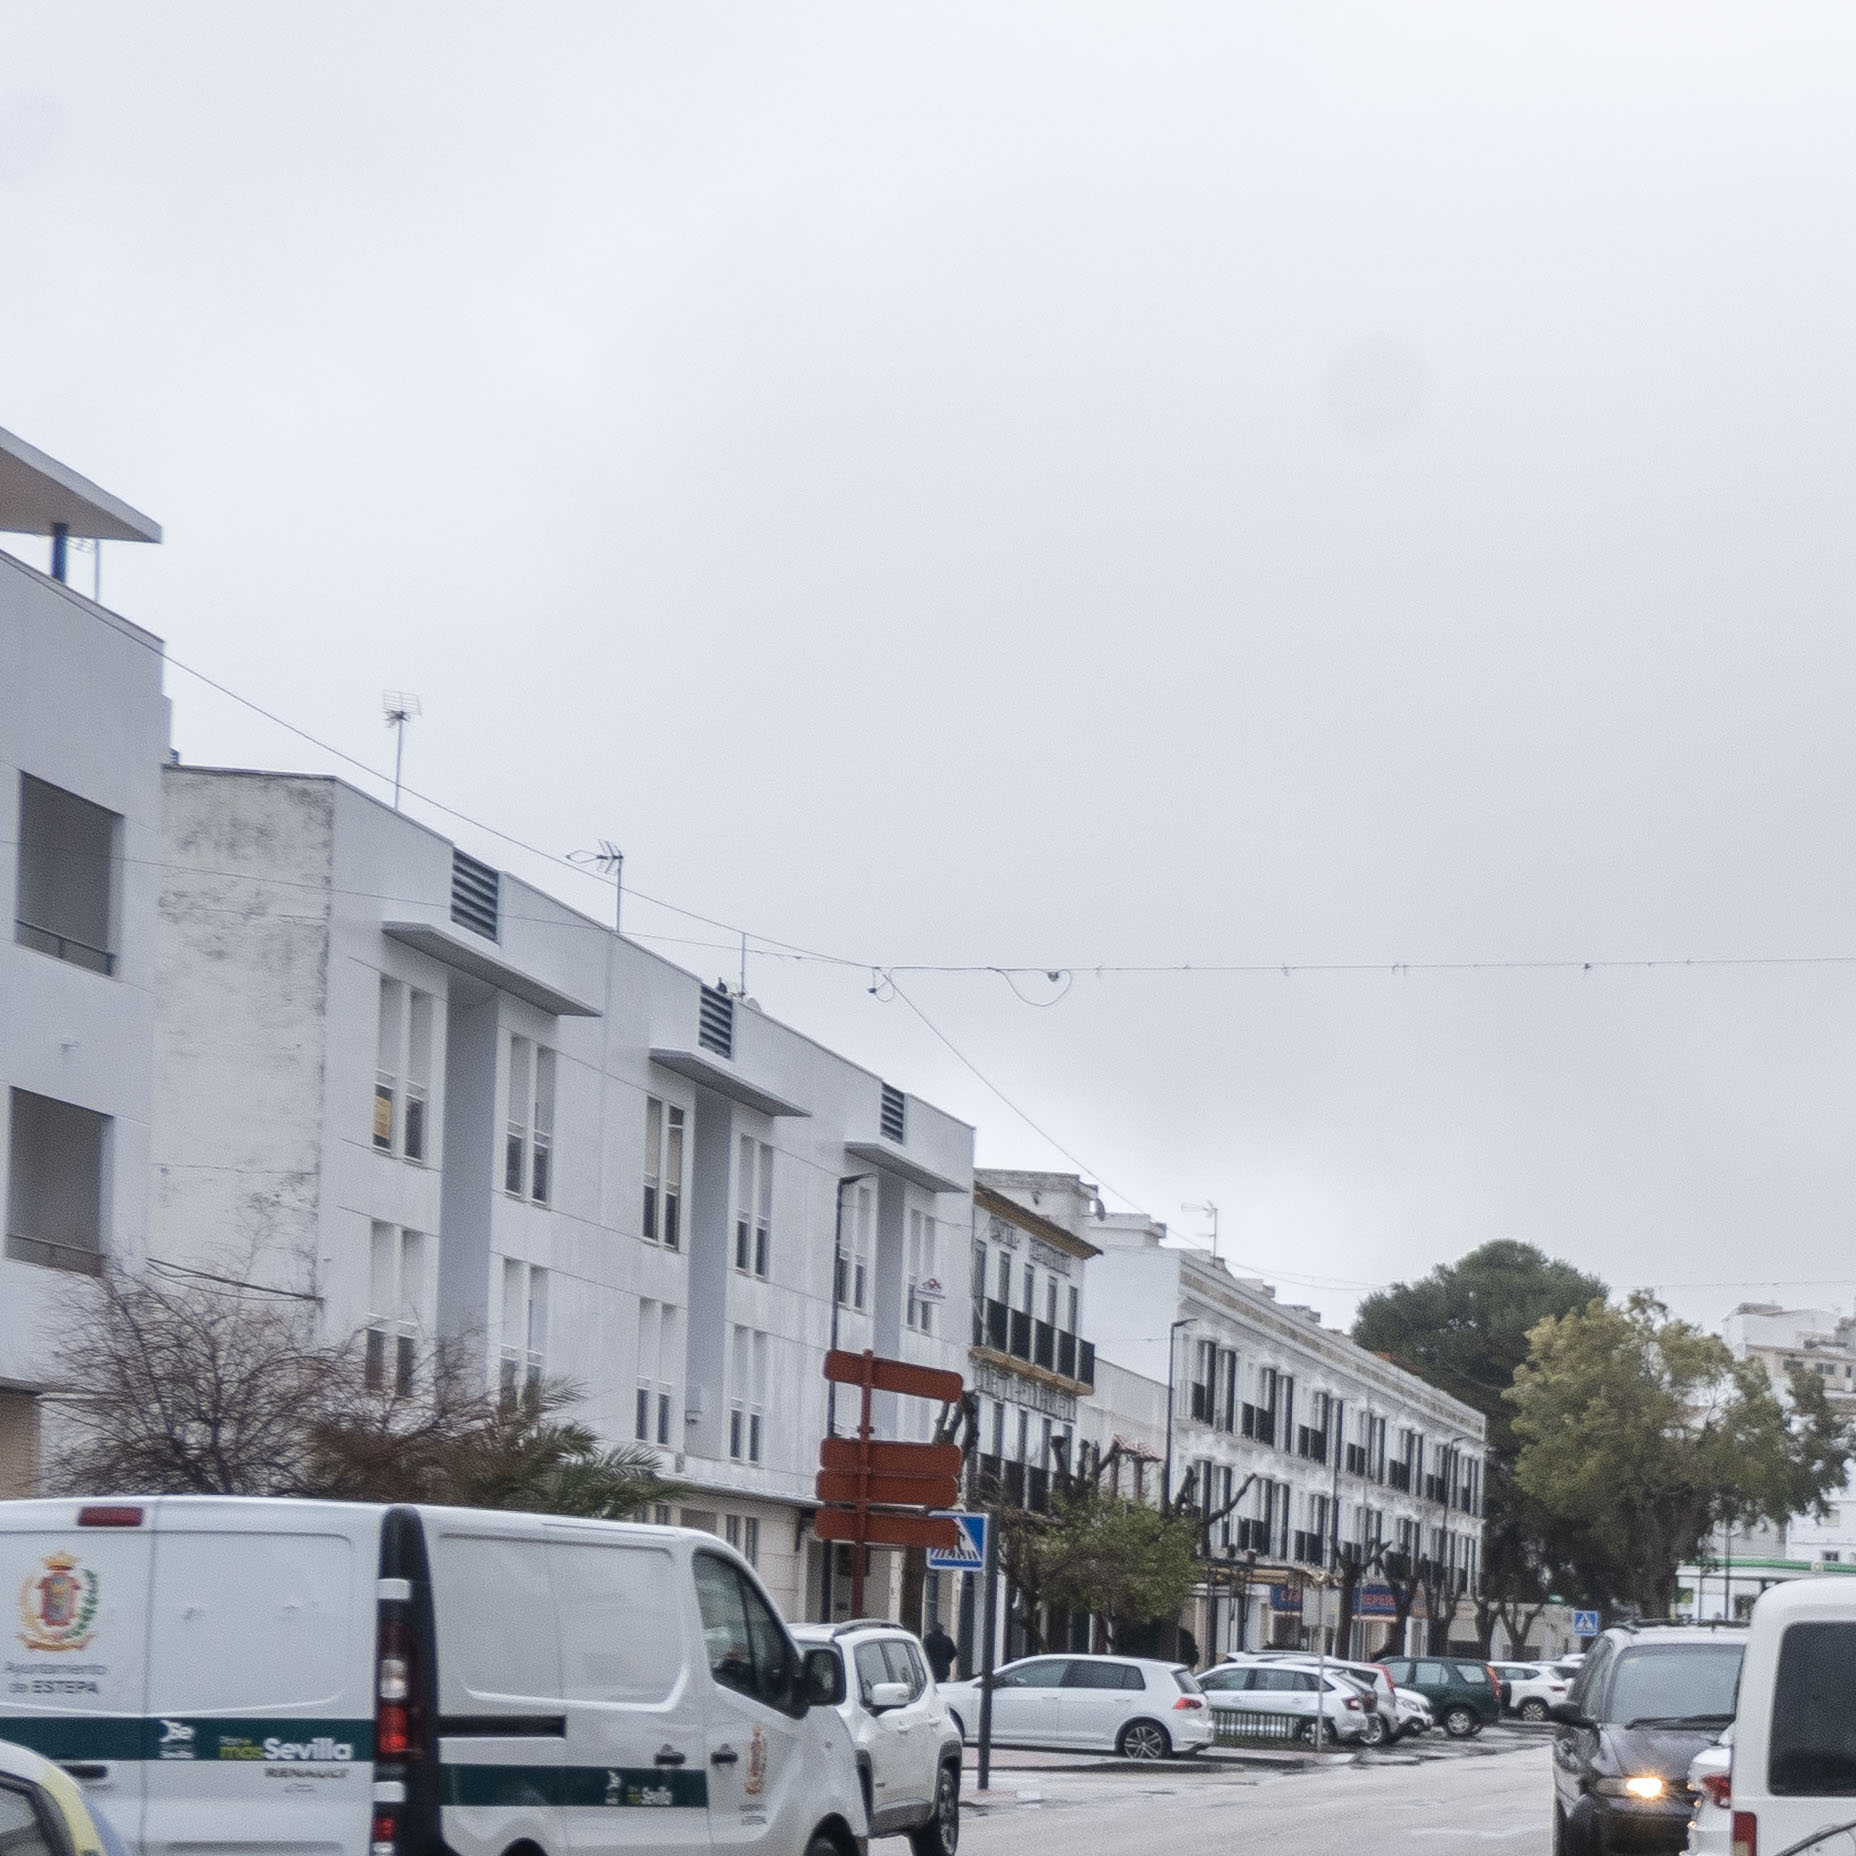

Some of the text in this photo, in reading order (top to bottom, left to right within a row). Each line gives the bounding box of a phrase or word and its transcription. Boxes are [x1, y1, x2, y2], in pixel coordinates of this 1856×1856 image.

[32, 1680, 99, 1694] ESTEPA
[263, 1737, 353, 1760] Sevilla
[265, 1767, 349, 1778] RENAULT
